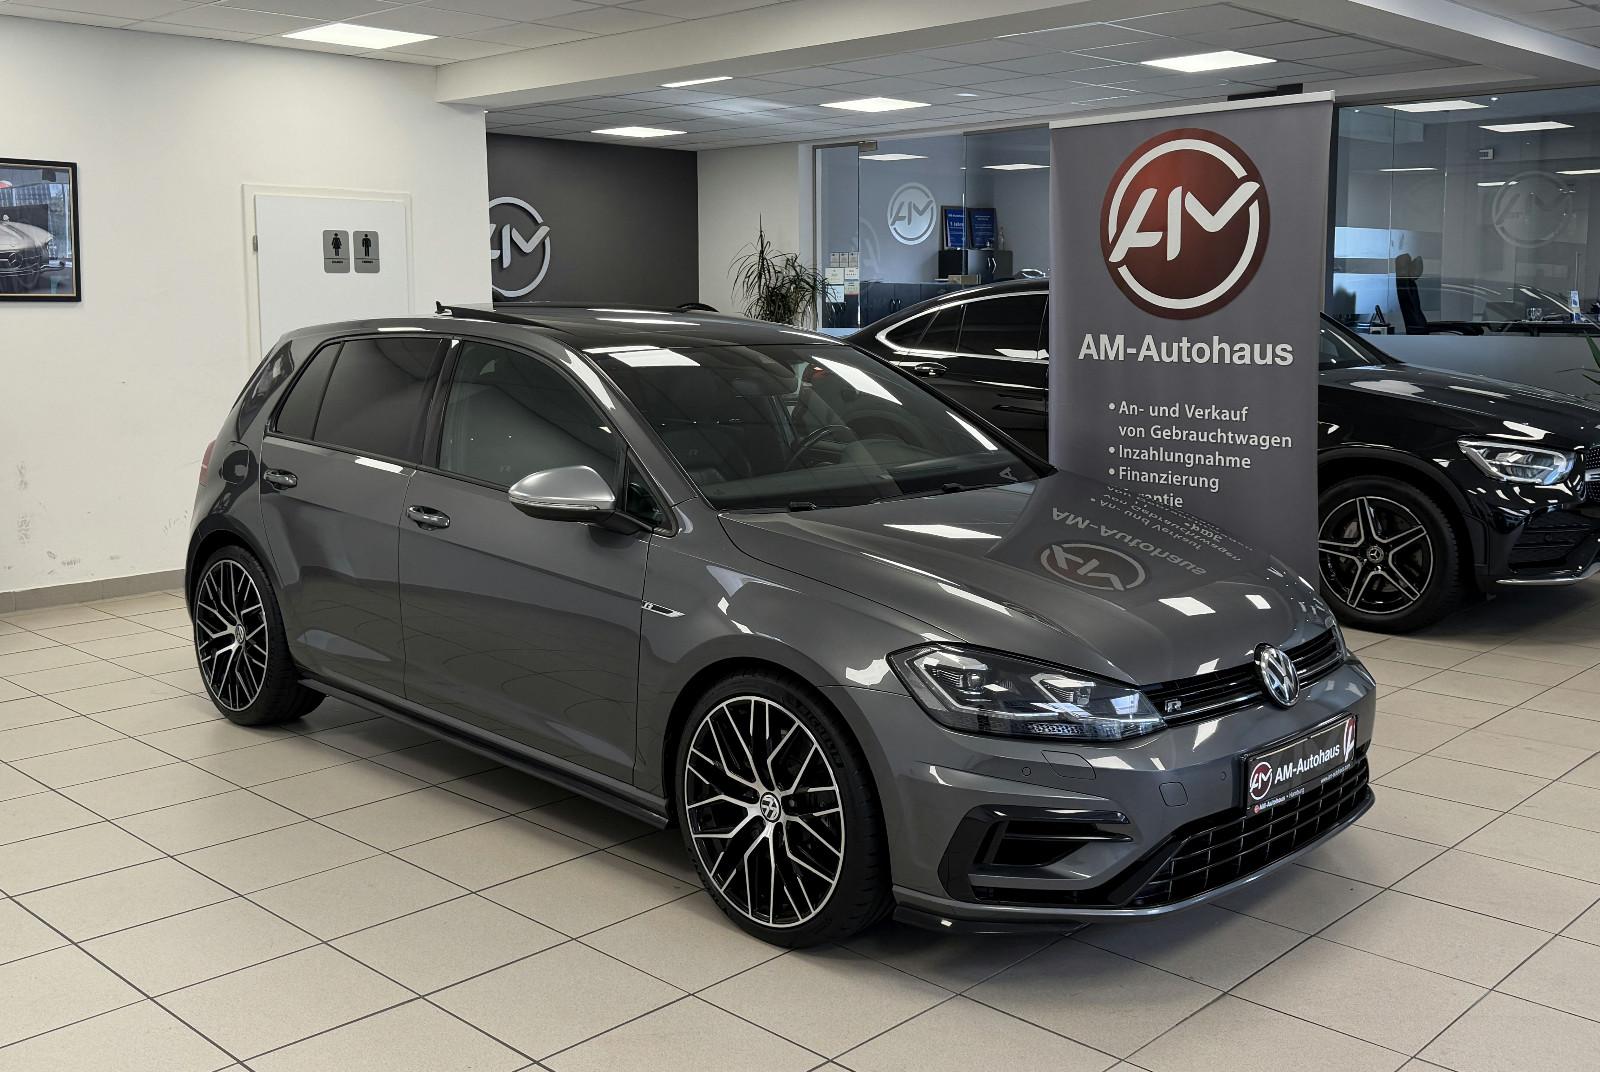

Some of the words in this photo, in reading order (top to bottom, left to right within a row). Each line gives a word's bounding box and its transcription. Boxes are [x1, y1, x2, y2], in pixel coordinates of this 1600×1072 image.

[889, 199, 935, 227] AM
[1108, 181, 1261, 262] AM
[1078, 333, 1294, 366] AM-Autohaus
[1118, 401, 1145, 416] An-
[1149, 402, 1180, 418] und
[1185, 403, 1249, 422] Verkauf
[1118, 425, 1146, 438] von
[1150, 425, 1293, 450] Gebrauchtwagen
[1119, 444, 1252, 469] Inzahlungnahme
[1118, 466, 1220, 492] Finanzierung
[1164, 698, 1182, 713] R
[1274, 743, 1341, 785] AM-Autohaus
